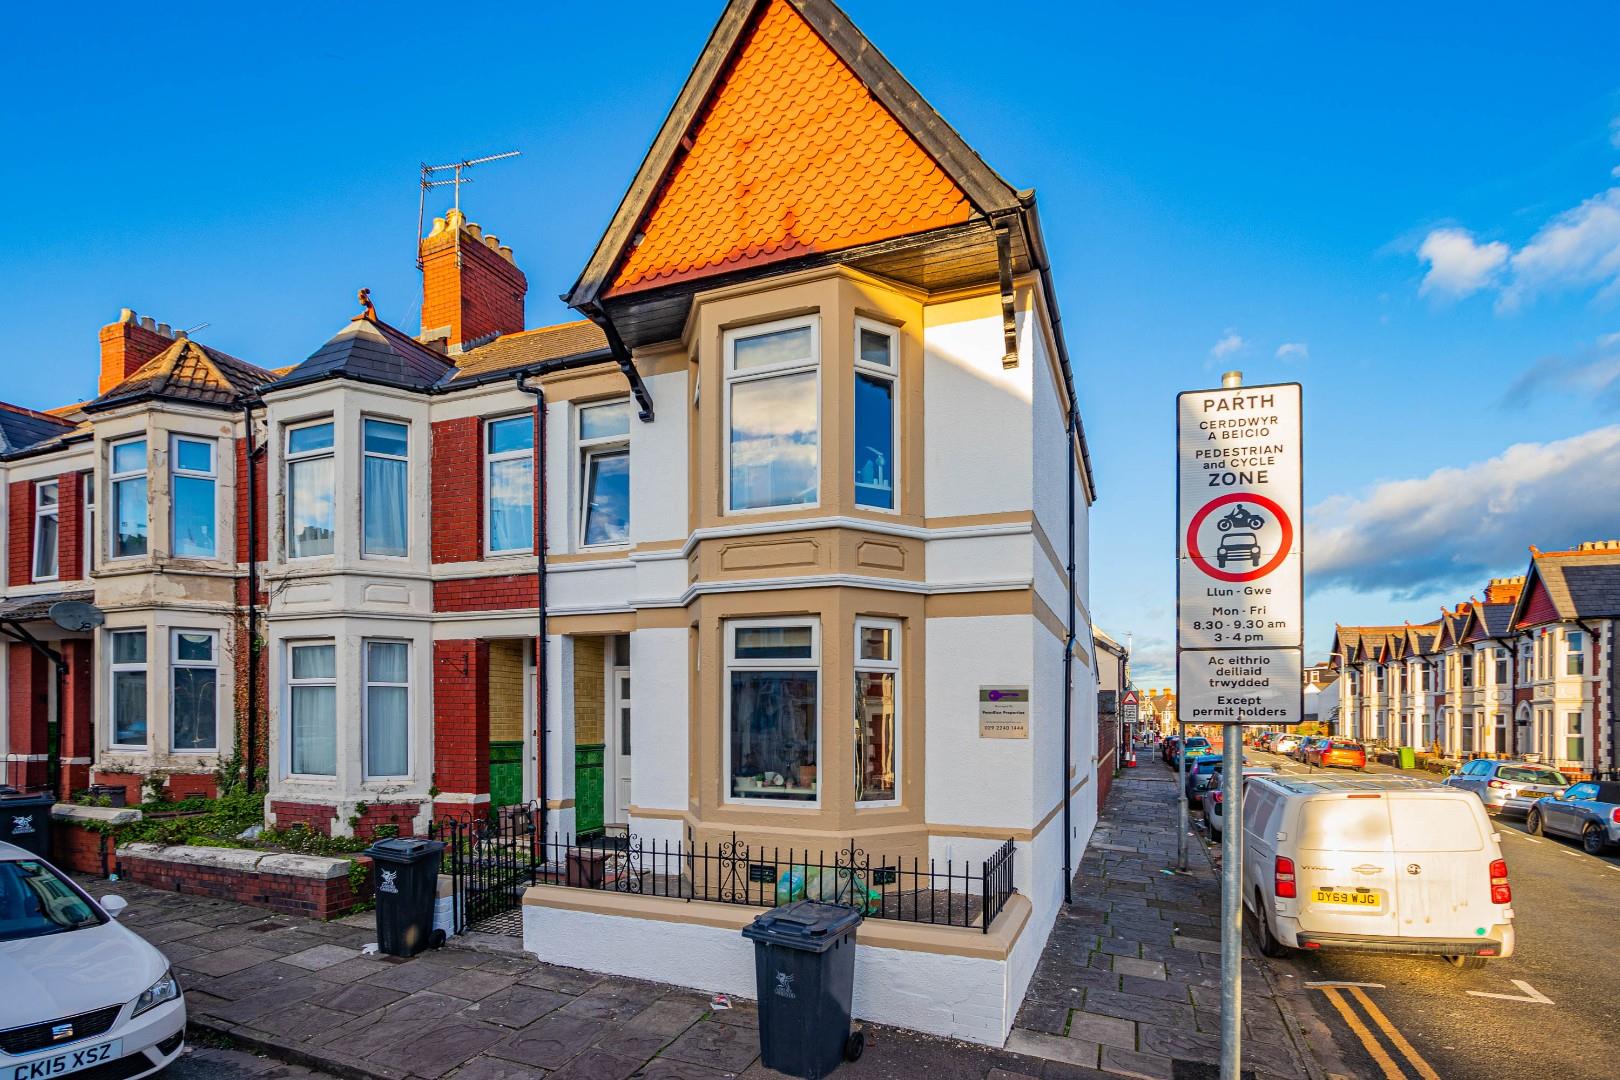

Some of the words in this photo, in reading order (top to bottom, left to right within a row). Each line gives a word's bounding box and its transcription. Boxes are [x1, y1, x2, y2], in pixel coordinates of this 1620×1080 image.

[1204, 394, 1274, 412] PARTH
[1200, 416, 1278, 430] CERDDWYR
[1208, 432, 1216, 440] A
[1222, 428, 1270, 439] BEICIO
[1196, 444, 1283, 459] PEDESTRIAN
[1203, 460, 1225, 470] and
[1230, 457, 1275, 467] CYCLE
[1208, 470, 1268, 486] ZONE
[1207, 588, 1233, 596] Llun
[1244, 587, 1272, 595] Gwe
[1212, 607, 1239, 616] Mon
[1250, 606, 1266, 615] Fri
[1194, 621, 1223, 630] 8.30
[1234, 620, 1264, 629] 9.30
[1214, 633, 1222, 642] 3
[1233, 633, 1242, 641] 4
[1245, 634, 1264, 643] pm
[1208, 656, 1224, 665] Ac
[1228, 656, 1270, 665] eithrio
[1216, 667, 1262, 676] deiliaid
[1209, 678, 1269, 688] trwydded
[1218, 696, 1262, 706] Except
[1193, 707, 1234, 717] permit
[1239, 707, 1287, 716] holders
[1317, 892, 1348, 902] DY69
[1351, 894, 1375, 904] WJG
[14, 1056, 66, 1080] CK15
[72, 1044, 111, 1068] XSZ
